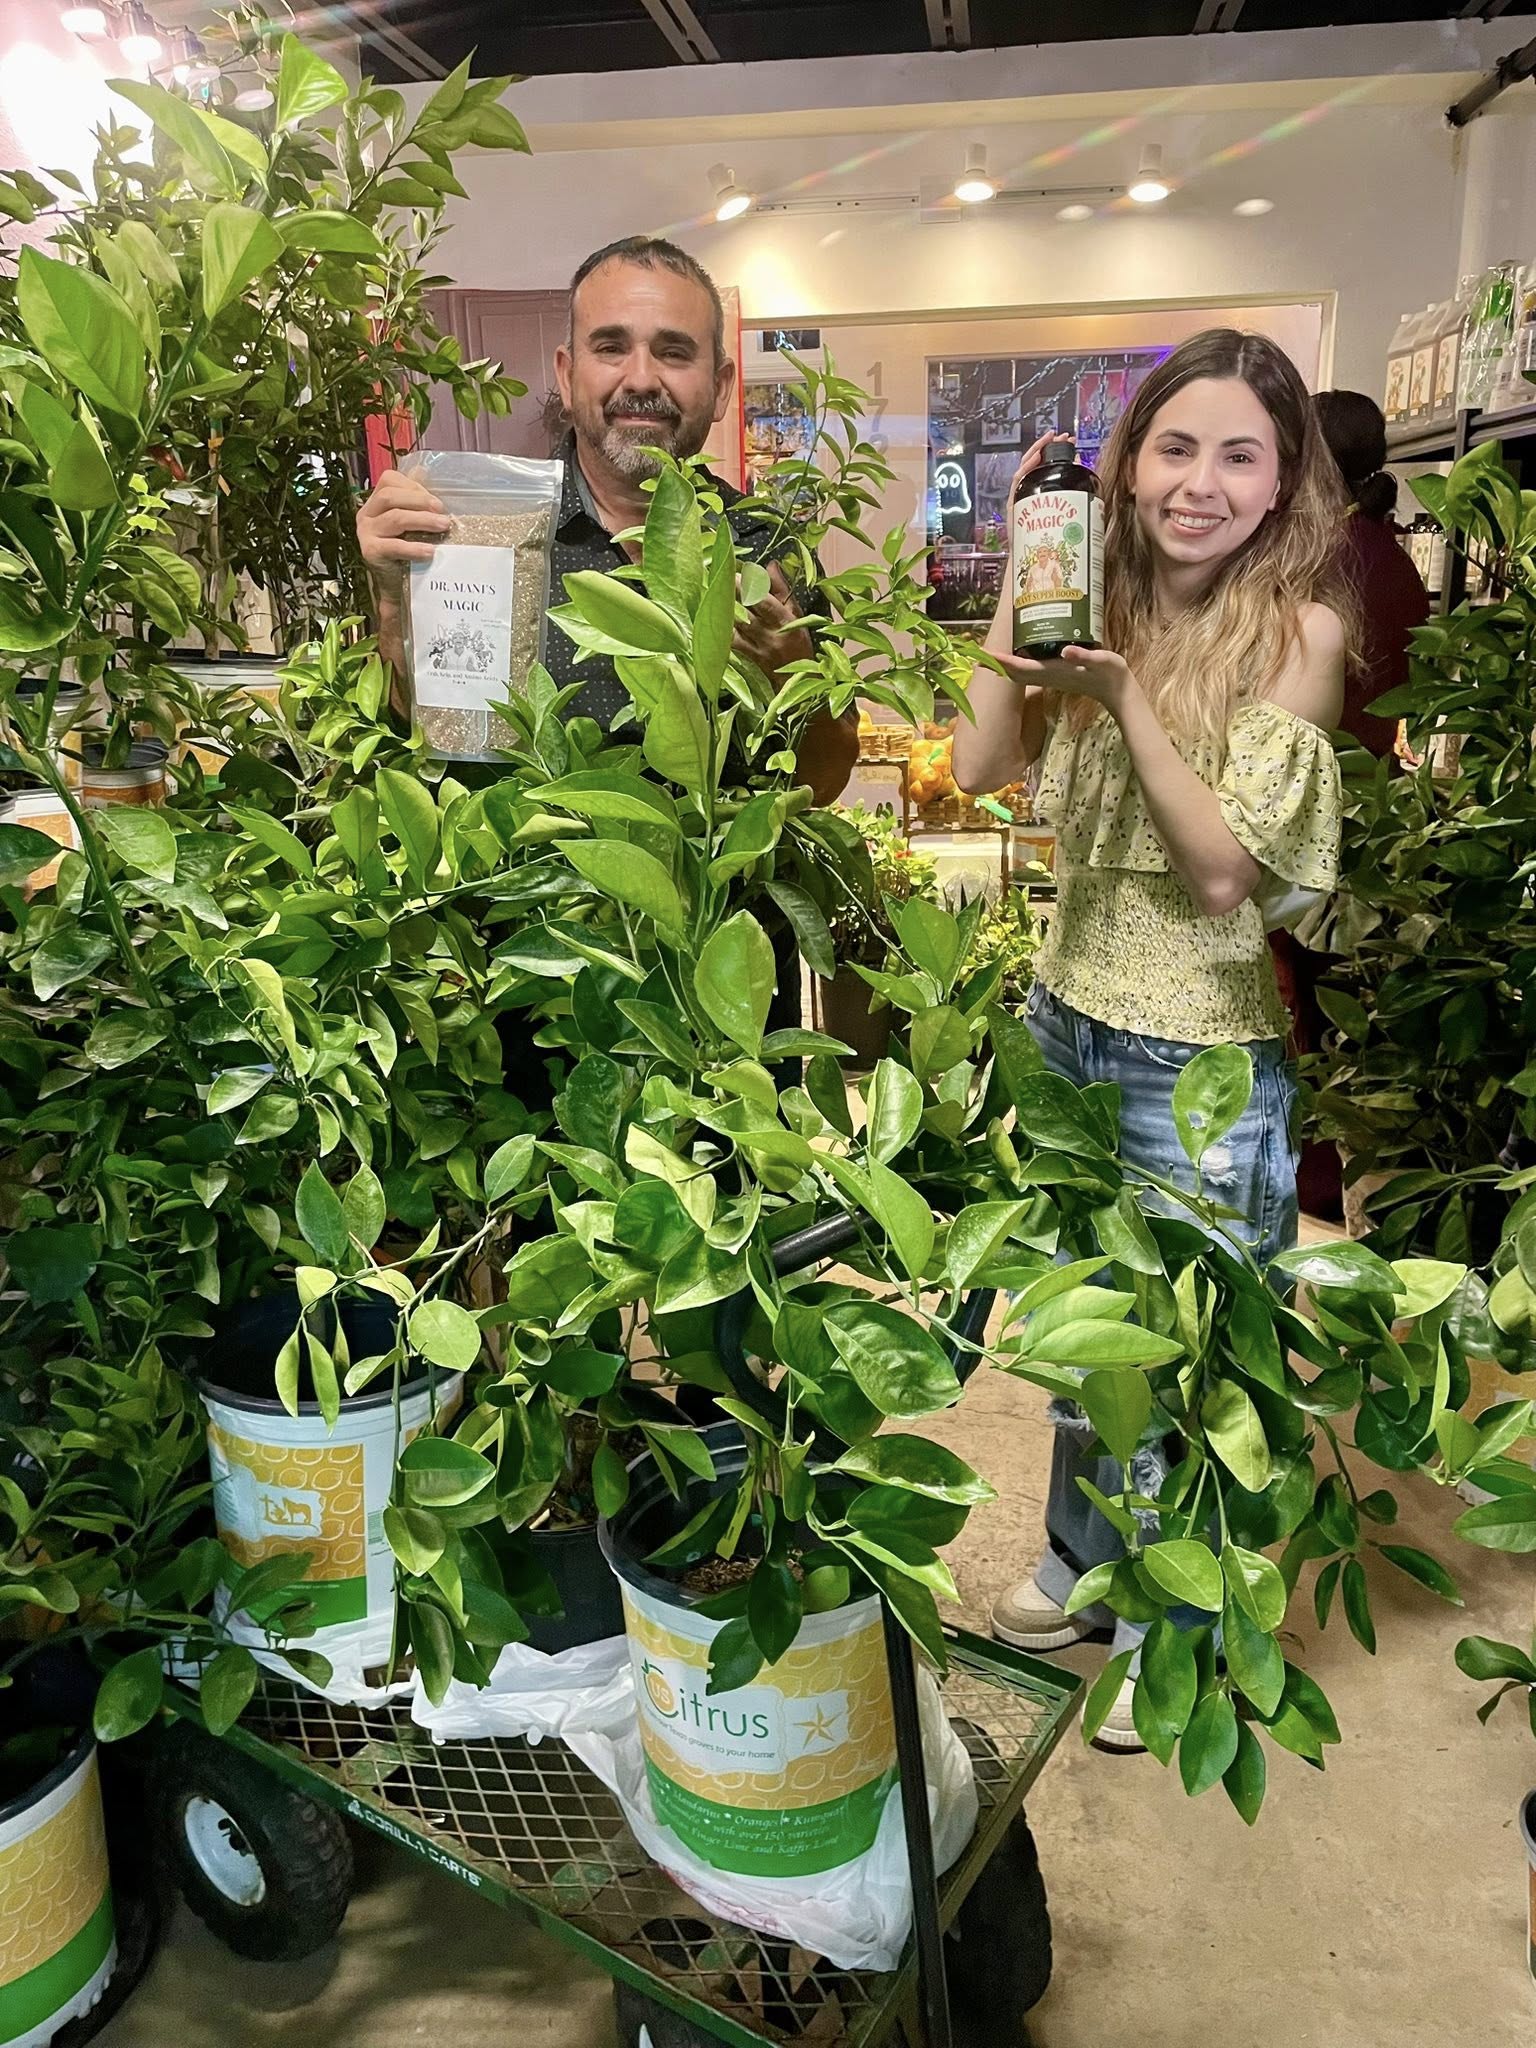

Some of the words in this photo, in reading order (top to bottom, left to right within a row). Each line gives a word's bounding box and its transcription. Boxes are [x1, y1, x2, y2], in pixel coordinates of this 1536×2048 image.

[1017, 507, 1031, 528] DR
[1031, 495, 1078, 519] MANI'S
[1026, 514, 1065, 533] MAGIC
[430, 580, 450, 592] DR.
[453, 581, 496, 595] MANI'S
[1033, 591, 1055, 601] SUPER
[1056, 589, 1080, 599] BOOST
[442, 599, 485, 612] MAGIC
[688, 1737, 714, 1752] groves
[715, 1745, 725, 1754] to
[726, 1748, 746, 1757] your
[748, 1750, 775, 1759] home
[713, 1824, 736, 1837] with
[738, 1831, 761, 1841] over
[764, 1830, 785, 1841] 150
[723, 1839, 751, 1852] Lime
[753, 1844, 774, 1854] and
[427, 1847, 482, 1887] CARTS
